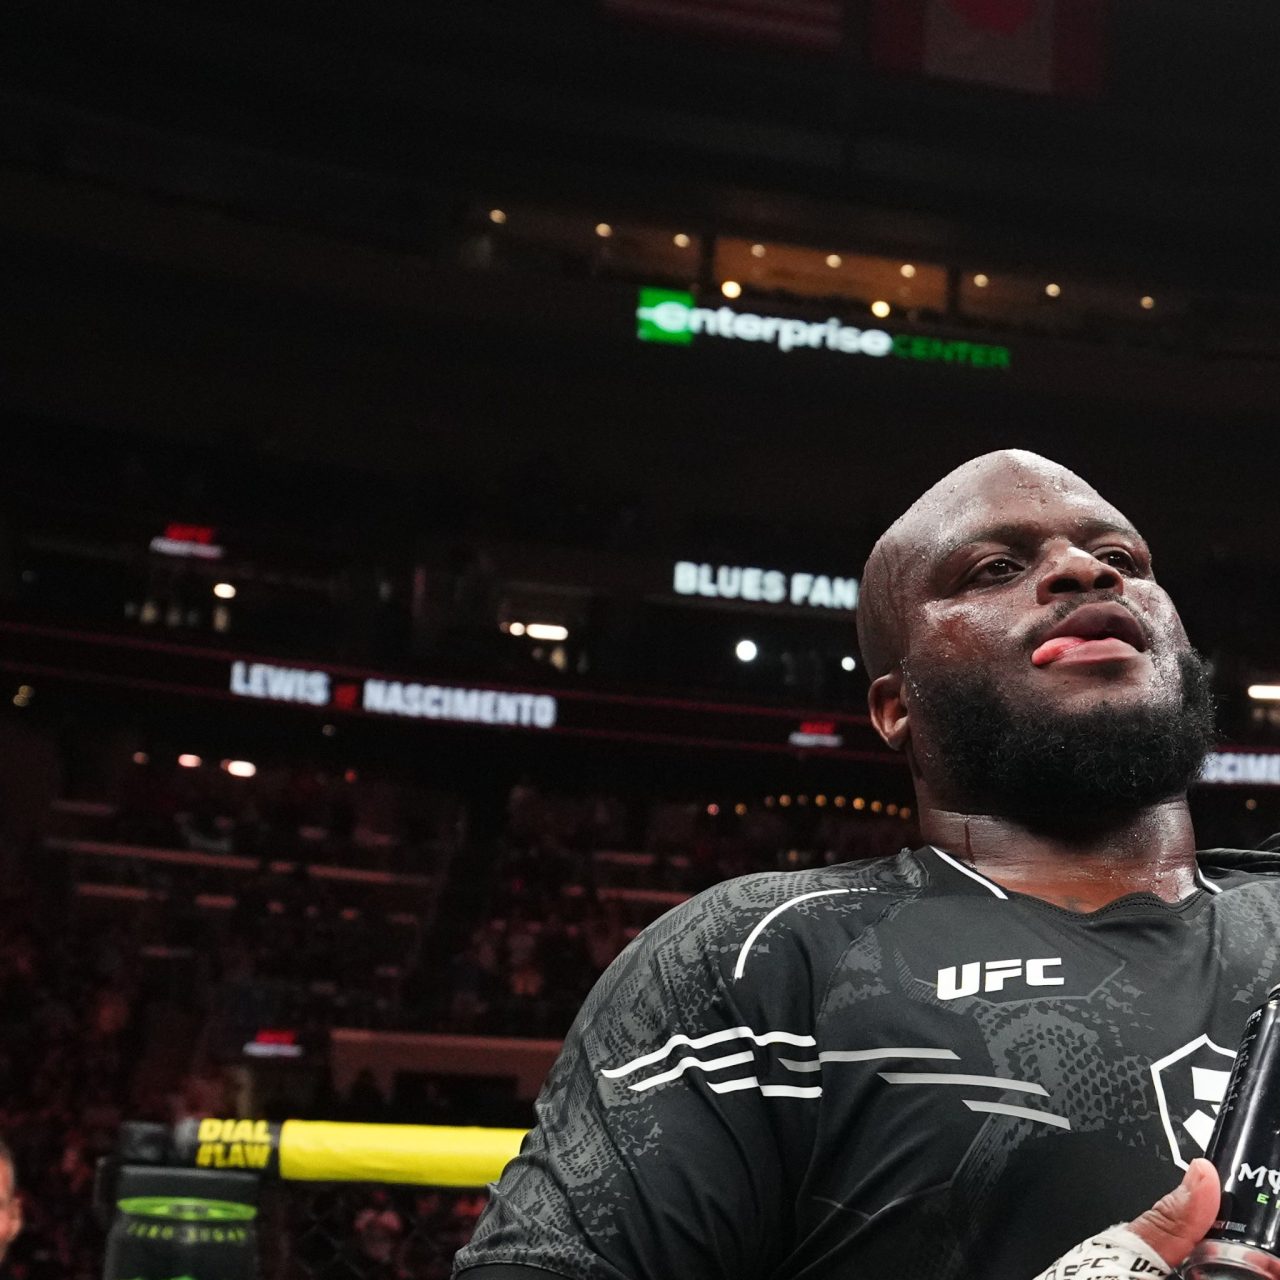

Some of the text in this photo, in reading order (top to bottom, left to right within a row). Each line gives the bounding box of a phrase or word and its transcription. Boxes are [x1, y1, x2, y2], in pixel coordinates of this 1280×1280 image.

[638, 301, 893, 353] enterprise
[673, 560, 786, 603] BLUES
[230, 660, 330, 706] LEWIS
[363, 678, 556, 729] NASCIMENTO
[936, 957, 1066, 1001] UFC
[198, 1118, 271, 1142] DIAL
